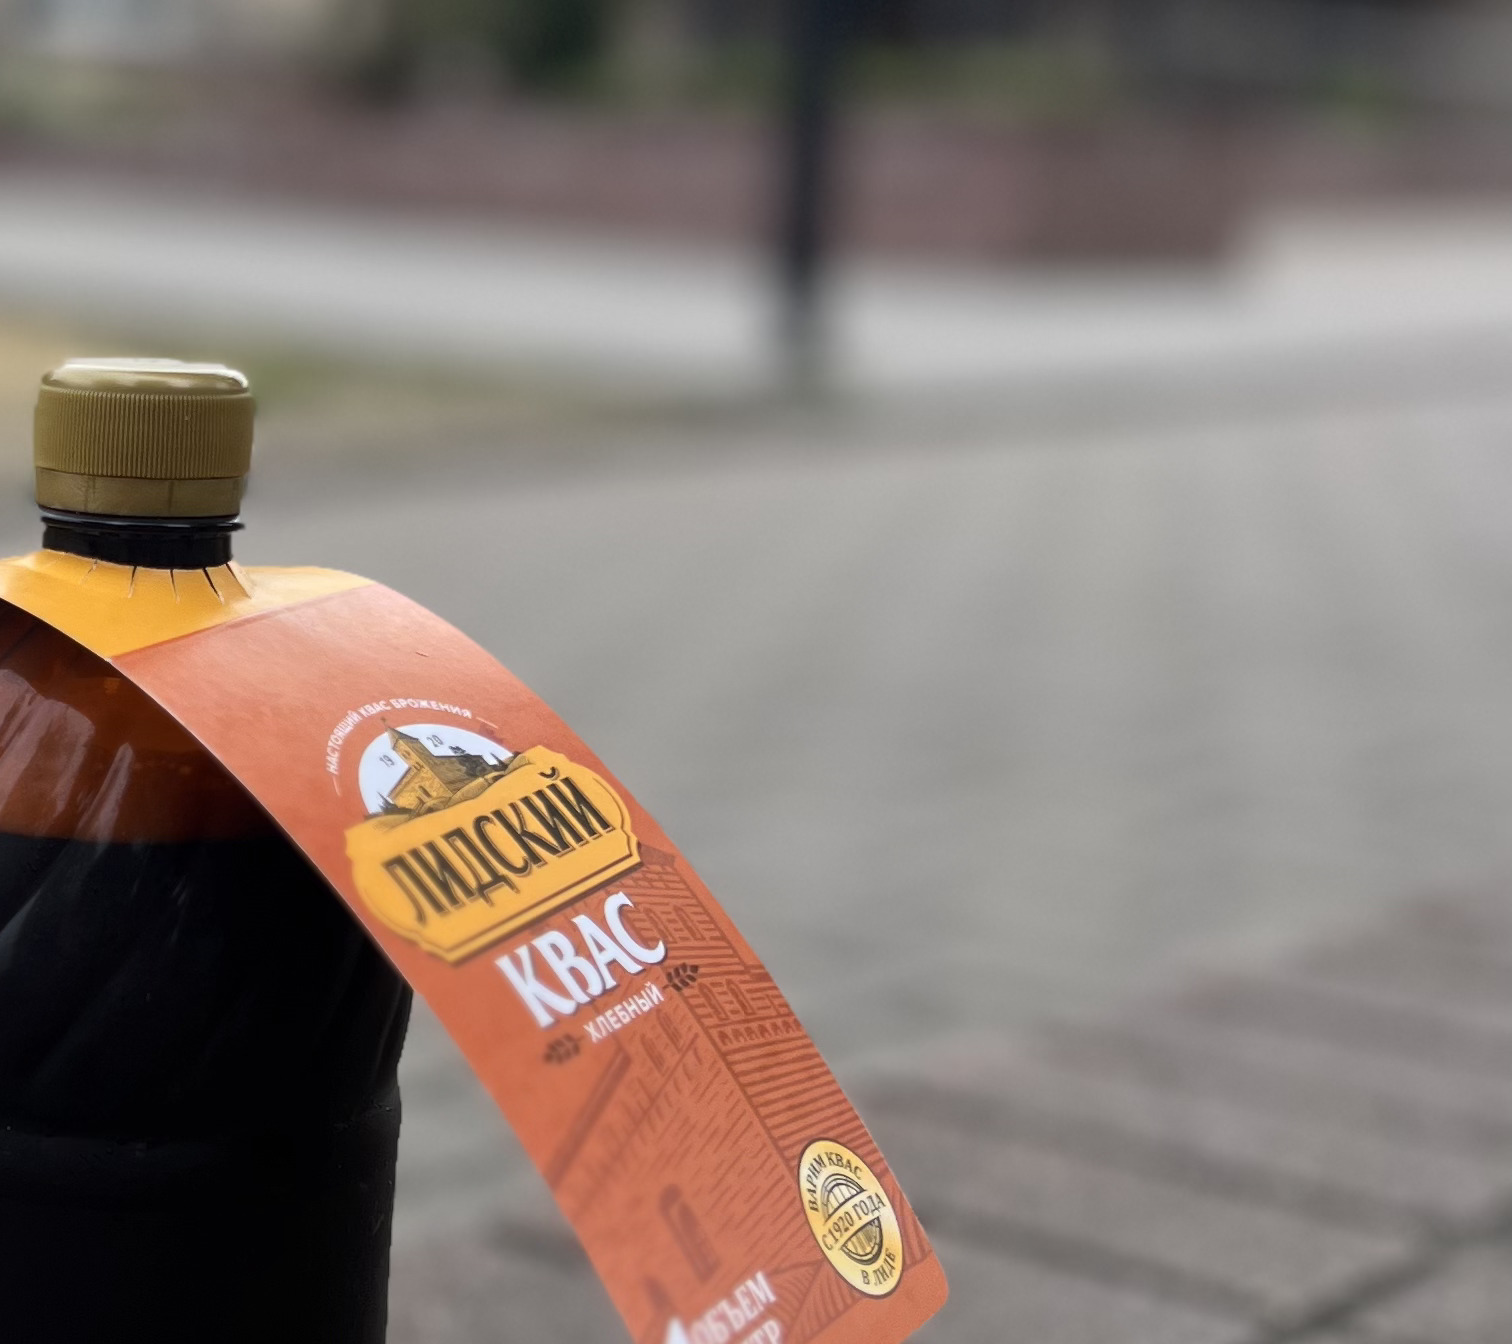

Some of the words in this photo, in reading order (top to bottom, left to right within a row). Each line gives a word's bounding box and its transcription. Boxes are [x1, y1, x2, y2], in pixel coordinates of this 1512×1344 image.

[326, 709, 363, 775] НАСТОЯЩИЙ
[357, 700, 392, 718] КВАС
[389, 698, 472, 719] БРОЖЕНИЯ
[379, 754, 396, 768] 19
[426, 734, 444, 748] 20
[381, 766, 615, 929] ЛИДСКИЙ
[495, 891, 667, 1029] КВАС
[583, 981, 665, 1043] ХЛЕБНЫЙ
[806, 1154, 827, 1213] ВАРИМ
[824, 1151, 863, 1181] КВАС
[827, 1210, 856, 1246] 1920
[851, 1192, 887, 1221] ГОДА
[859, 1269, 871, 1286] В
[873, 1247, 897, 1287] ЛИДЕ
